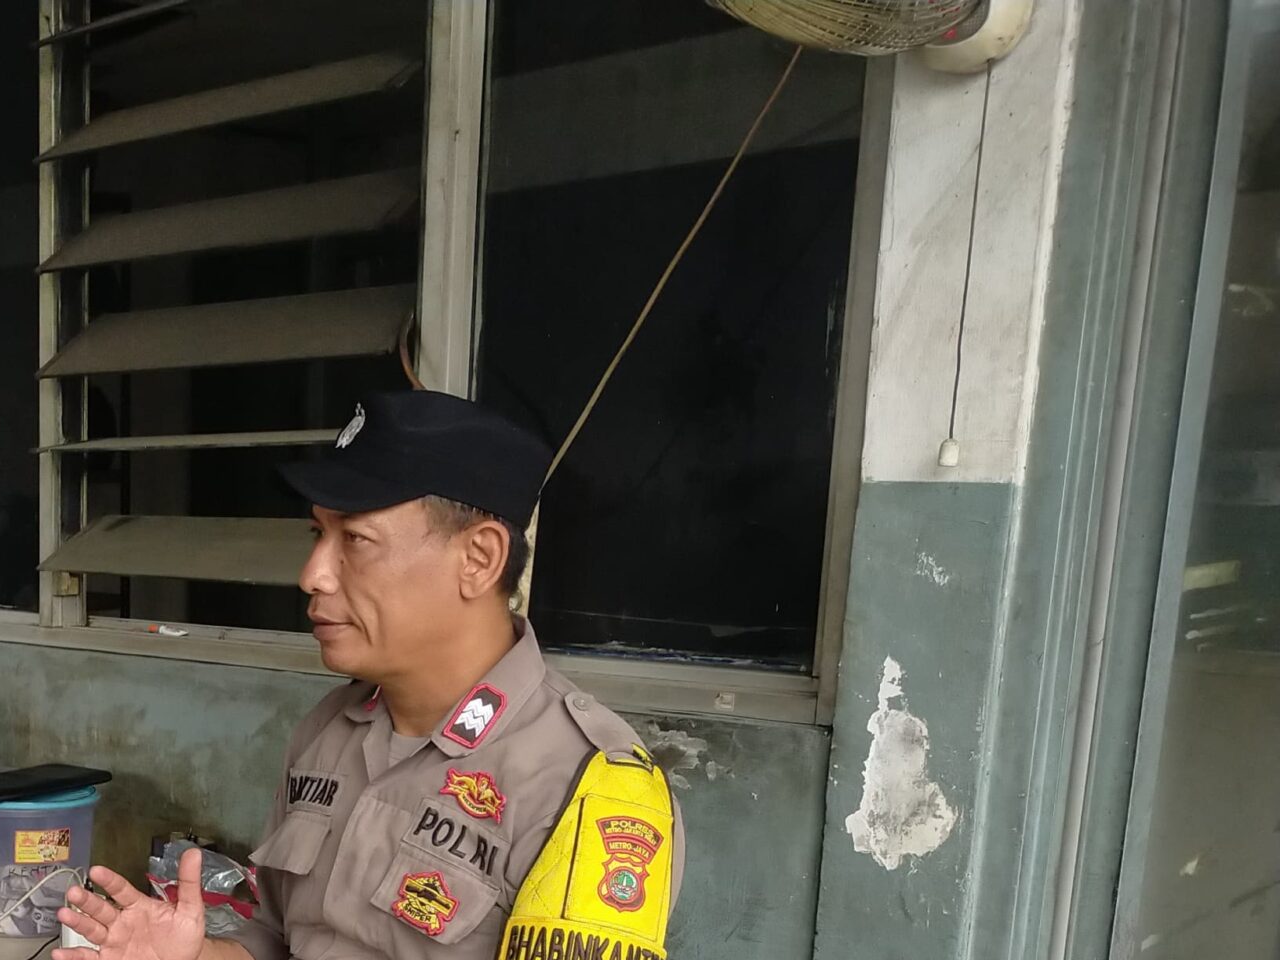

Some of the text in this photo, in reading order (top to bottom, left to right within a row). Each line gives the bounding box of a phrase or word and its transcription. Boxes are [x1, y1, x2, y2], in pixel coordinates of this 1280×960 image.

[610, 820, 654, 837] POLRES
[413, 806, 500, 876] POLRI
[608, 841, 632, 850] METRO
[403, 902, 433, 922] SNIPER
